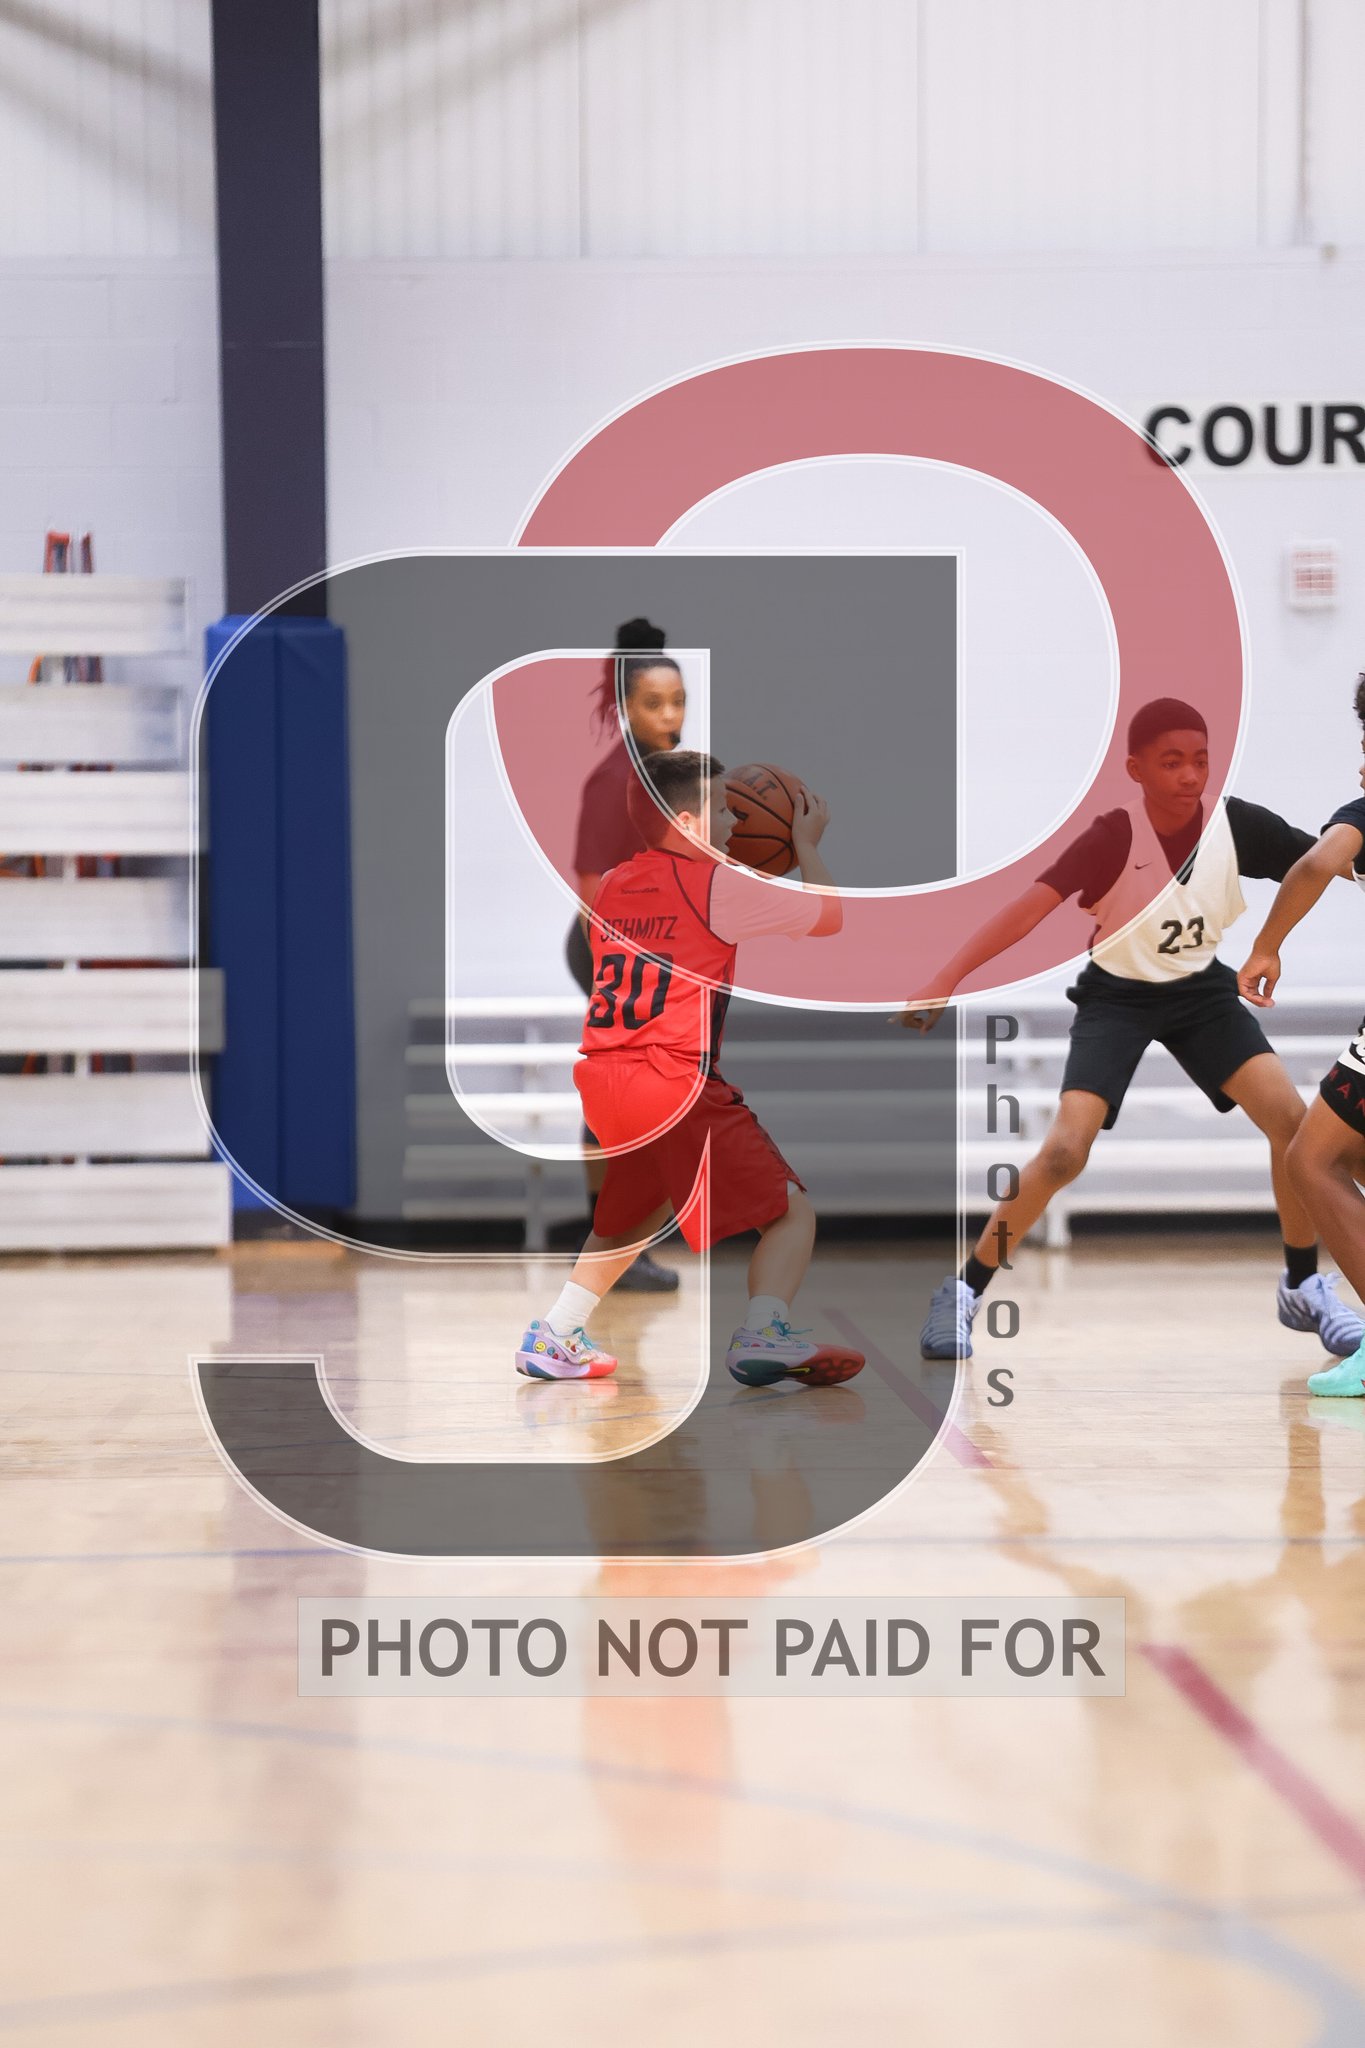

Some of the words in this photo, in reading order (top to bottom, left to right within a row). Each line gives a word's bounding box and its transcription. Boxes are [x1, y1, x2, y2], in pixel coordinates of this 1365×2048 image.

[1144, 405, 1365, 467] COUR
[601, 916, 678, 942] SCHMITZ
[1157, 916, 1205, 955] 23
[587, 952, 673, 1030] 30
